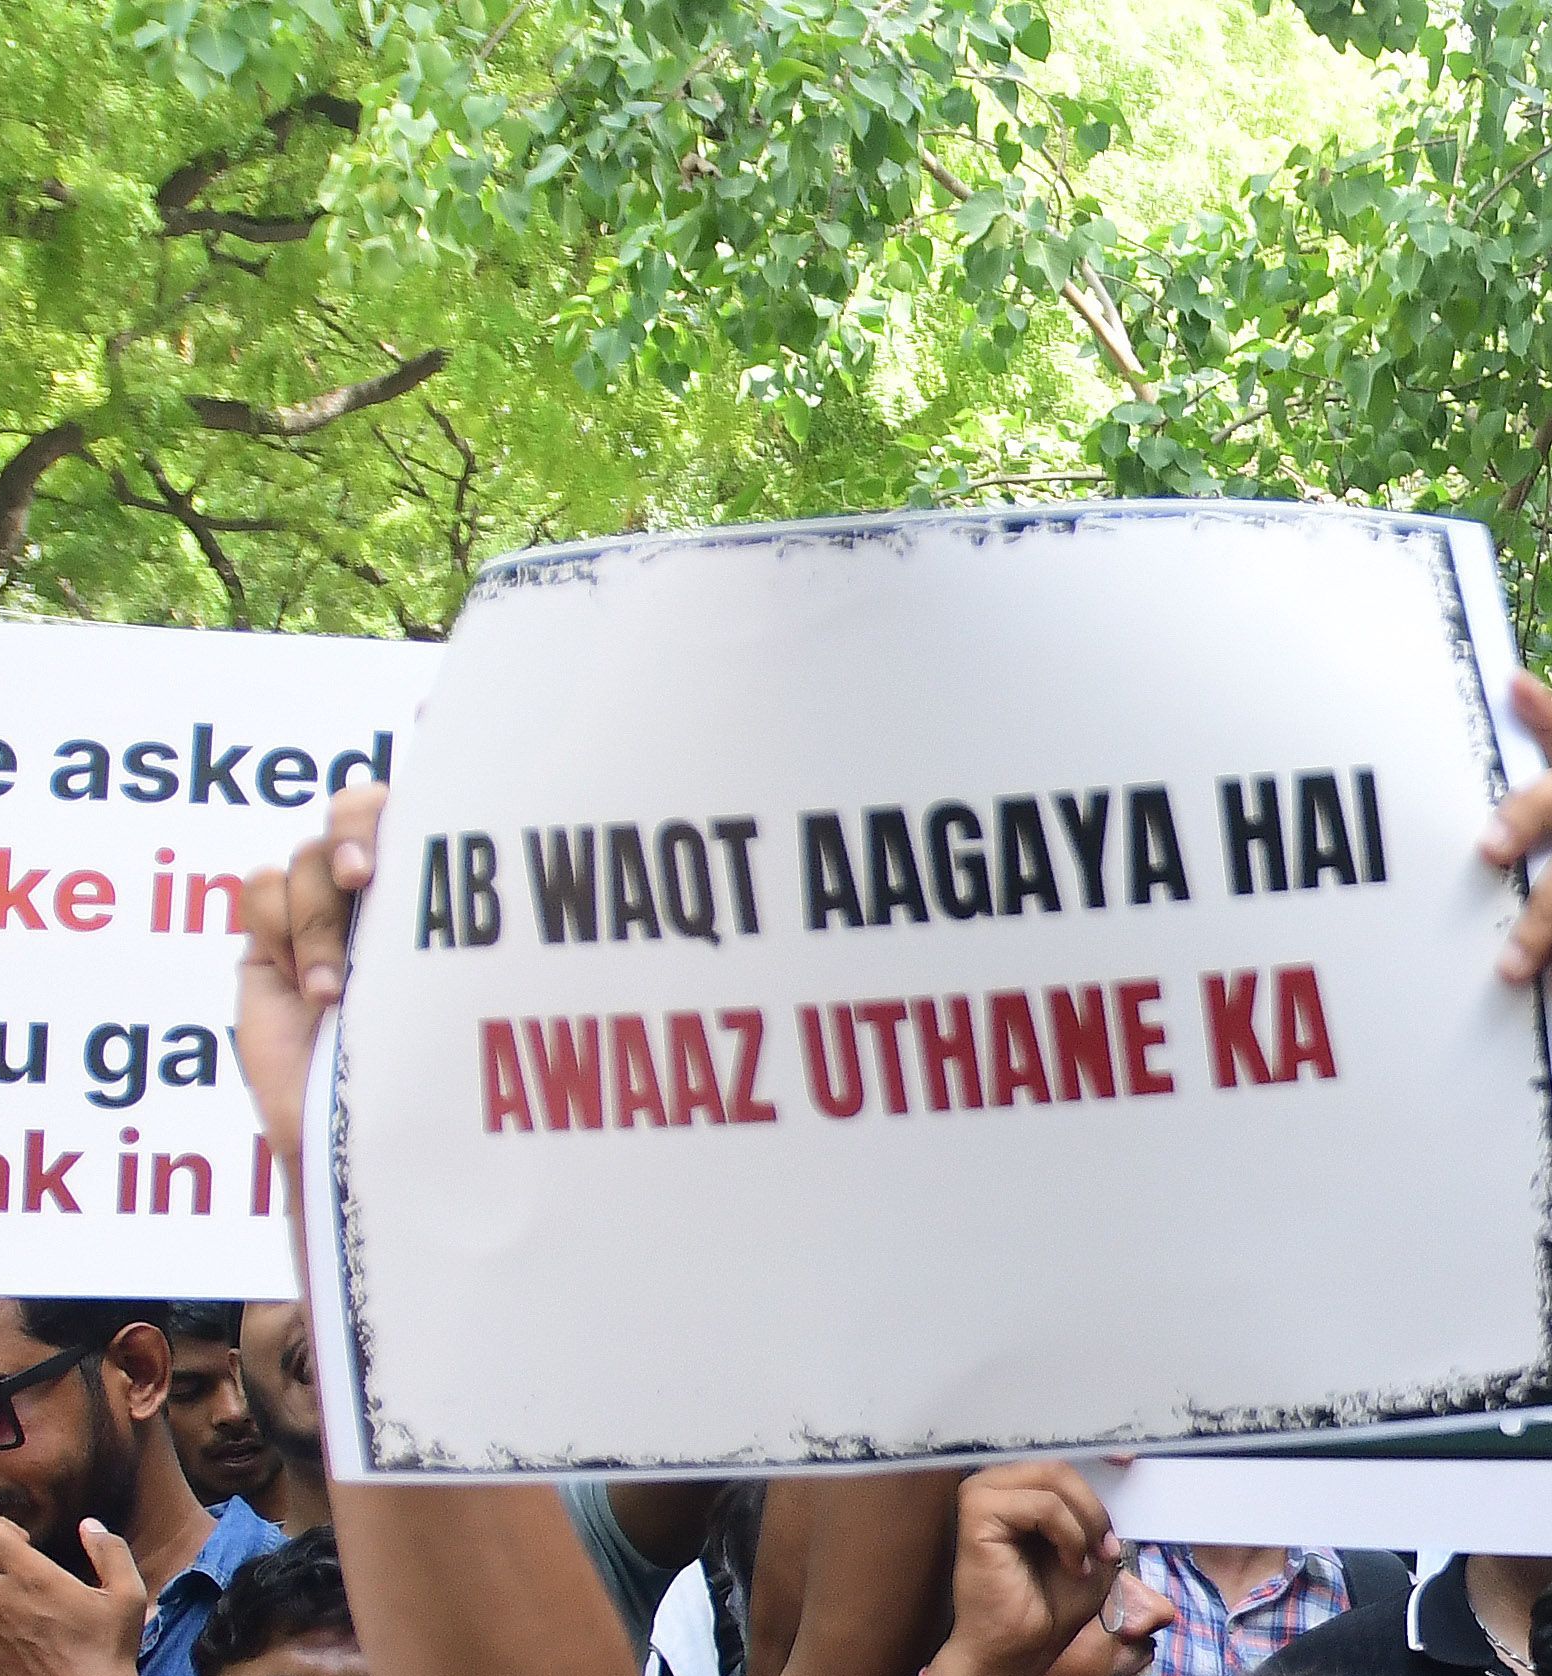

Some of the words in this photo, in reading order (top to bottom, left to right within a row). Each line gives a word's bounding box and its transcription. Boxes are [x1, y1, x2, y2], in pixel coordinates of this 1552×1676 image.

[50, 723, 393, 808] asked
[150, 847, 245, 933] in
[414, 831, 500, 951] AB
[520, 813, 759, 948] WAQT
[796, 781, 1190, 934] AAGAYA
[1215, 764, 1388, 896] HAI
[477, 1008, 777, 1137] AWAAZ
[792, 978, 1174, 1122] UTHANE
[1198, 961, 1337, 1090] KA
[116, 1126, 212, 1217] in
